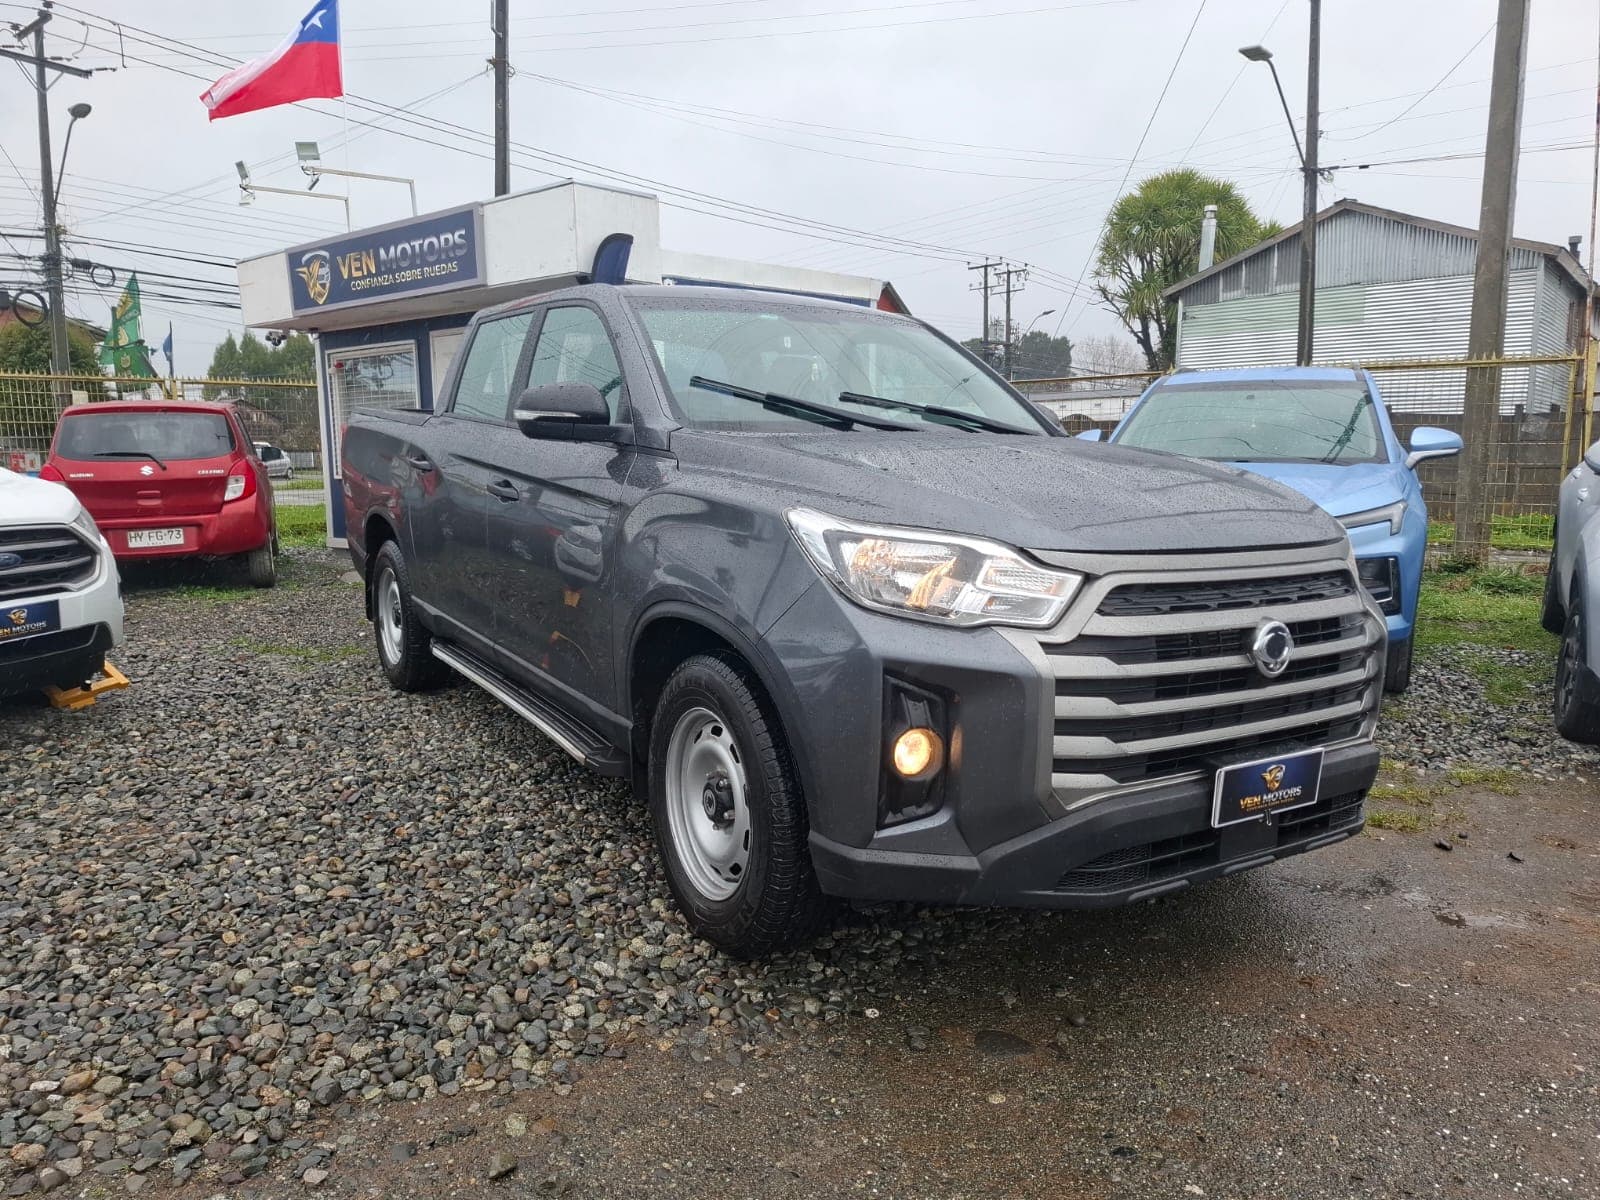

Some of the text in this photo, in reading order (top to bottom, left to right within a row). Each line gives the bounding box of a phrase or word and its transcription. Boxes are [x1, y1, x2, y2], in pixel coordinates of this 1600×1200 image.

[336, 228, 468, 280] VEN MOTORS
[350, 261, 458, 291] CONFIANZA SOBRE RUEDAS
[129, 532, 144, 543] HY
[12, 620, 47, 634] MOTORS
[1239, 794, 1262, 810] VEN
[1262, 785, 1303, 804] MOTORS
